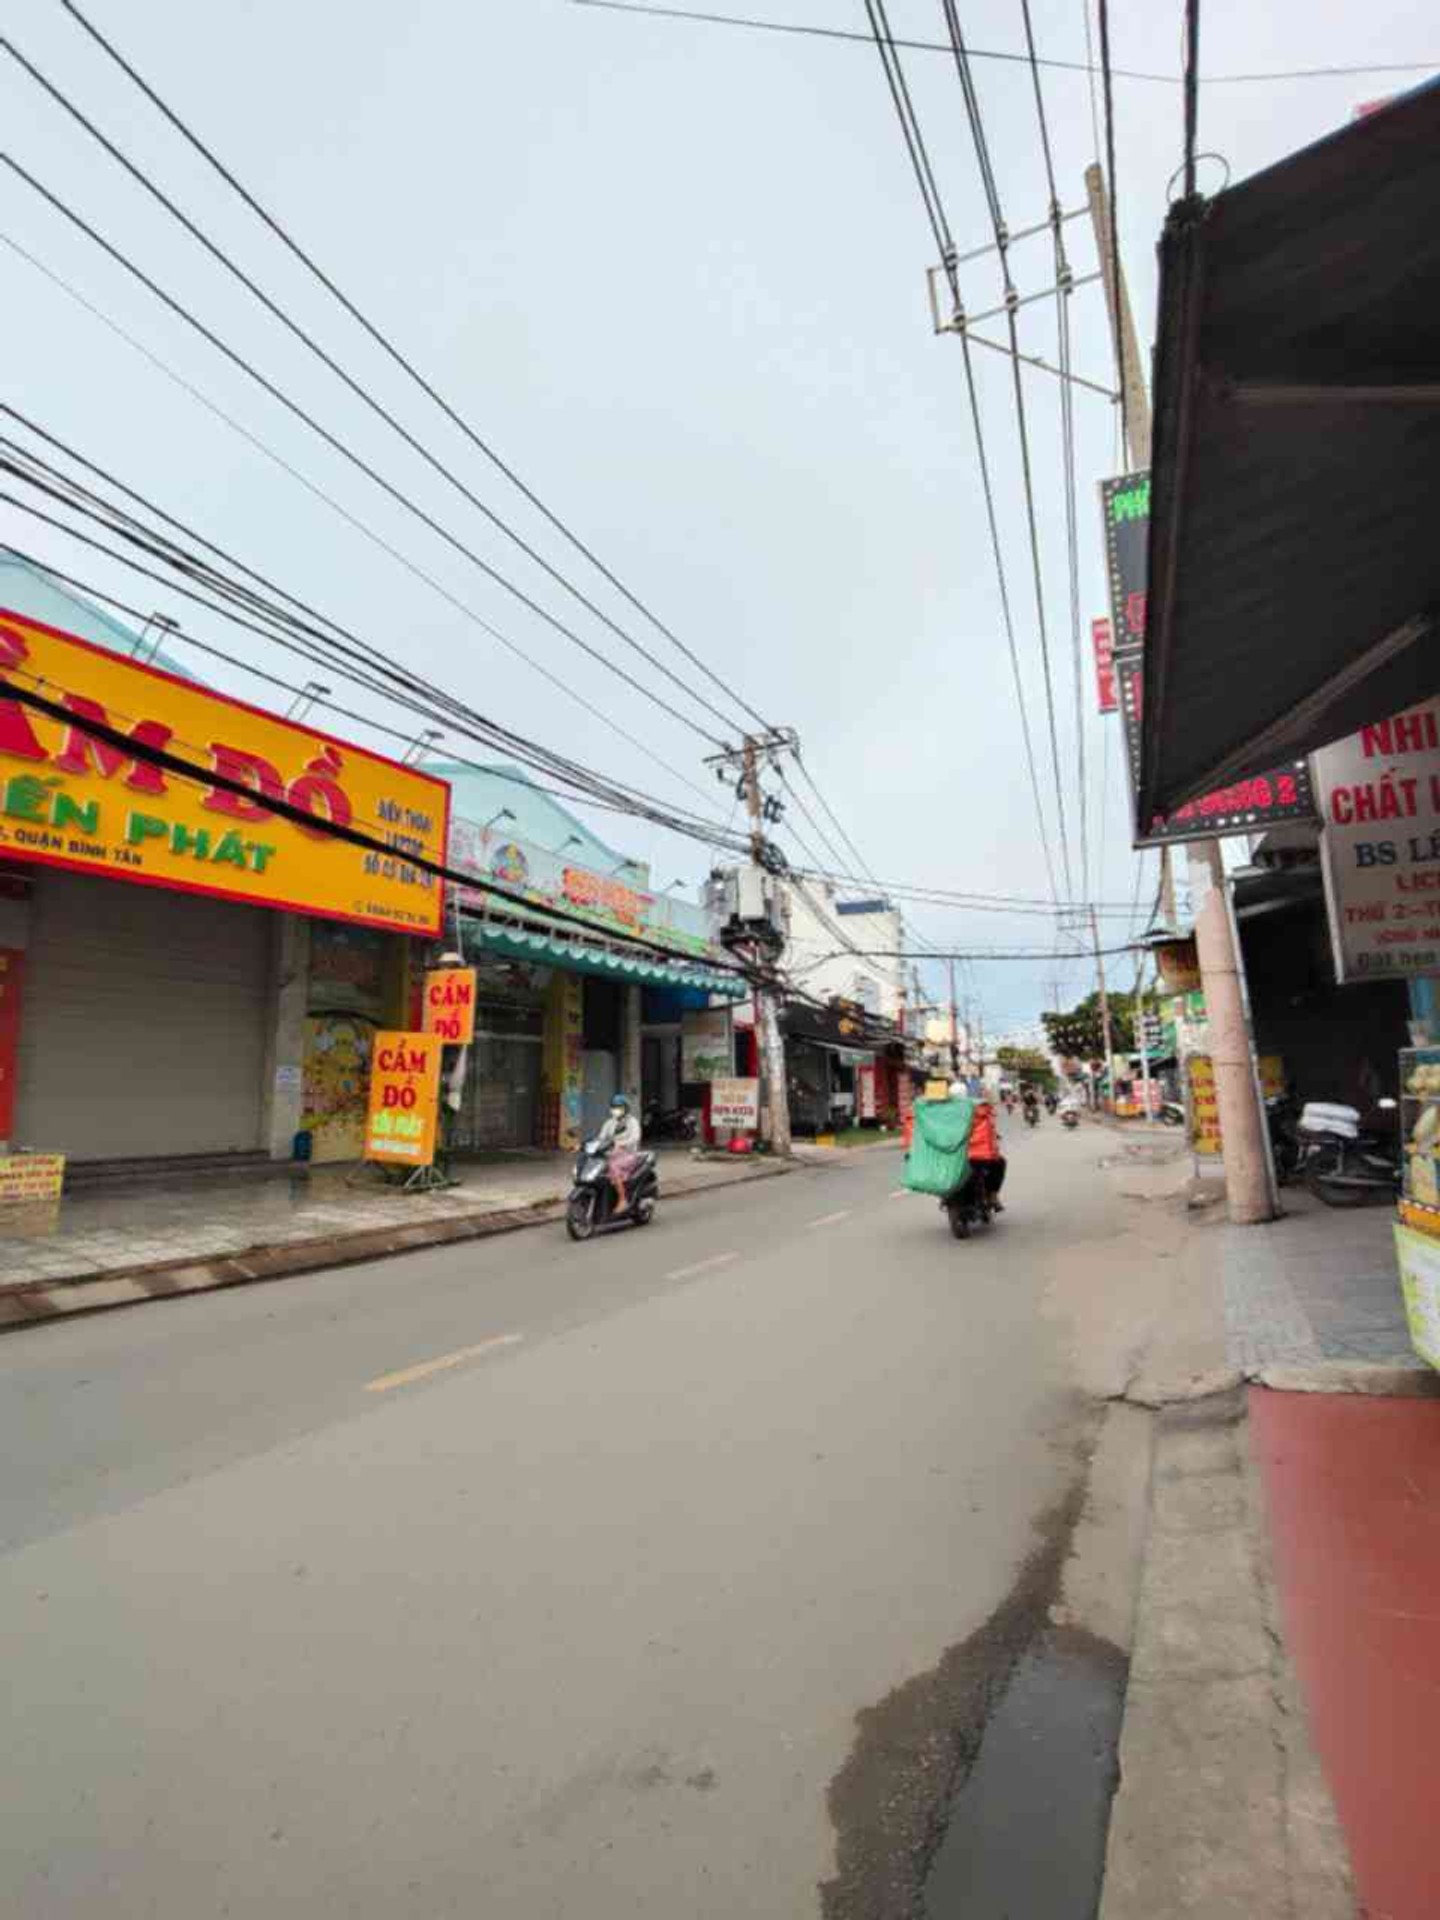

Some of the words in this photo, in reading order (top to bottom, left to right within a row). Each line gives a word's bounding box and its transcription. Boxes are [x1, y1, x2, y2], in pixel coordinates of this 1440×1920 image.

[1331, 766, 1418, 825] CHẤT
[127, 809, 277, 873] PHÁT
[1354, 841, 1396, 868] BS
